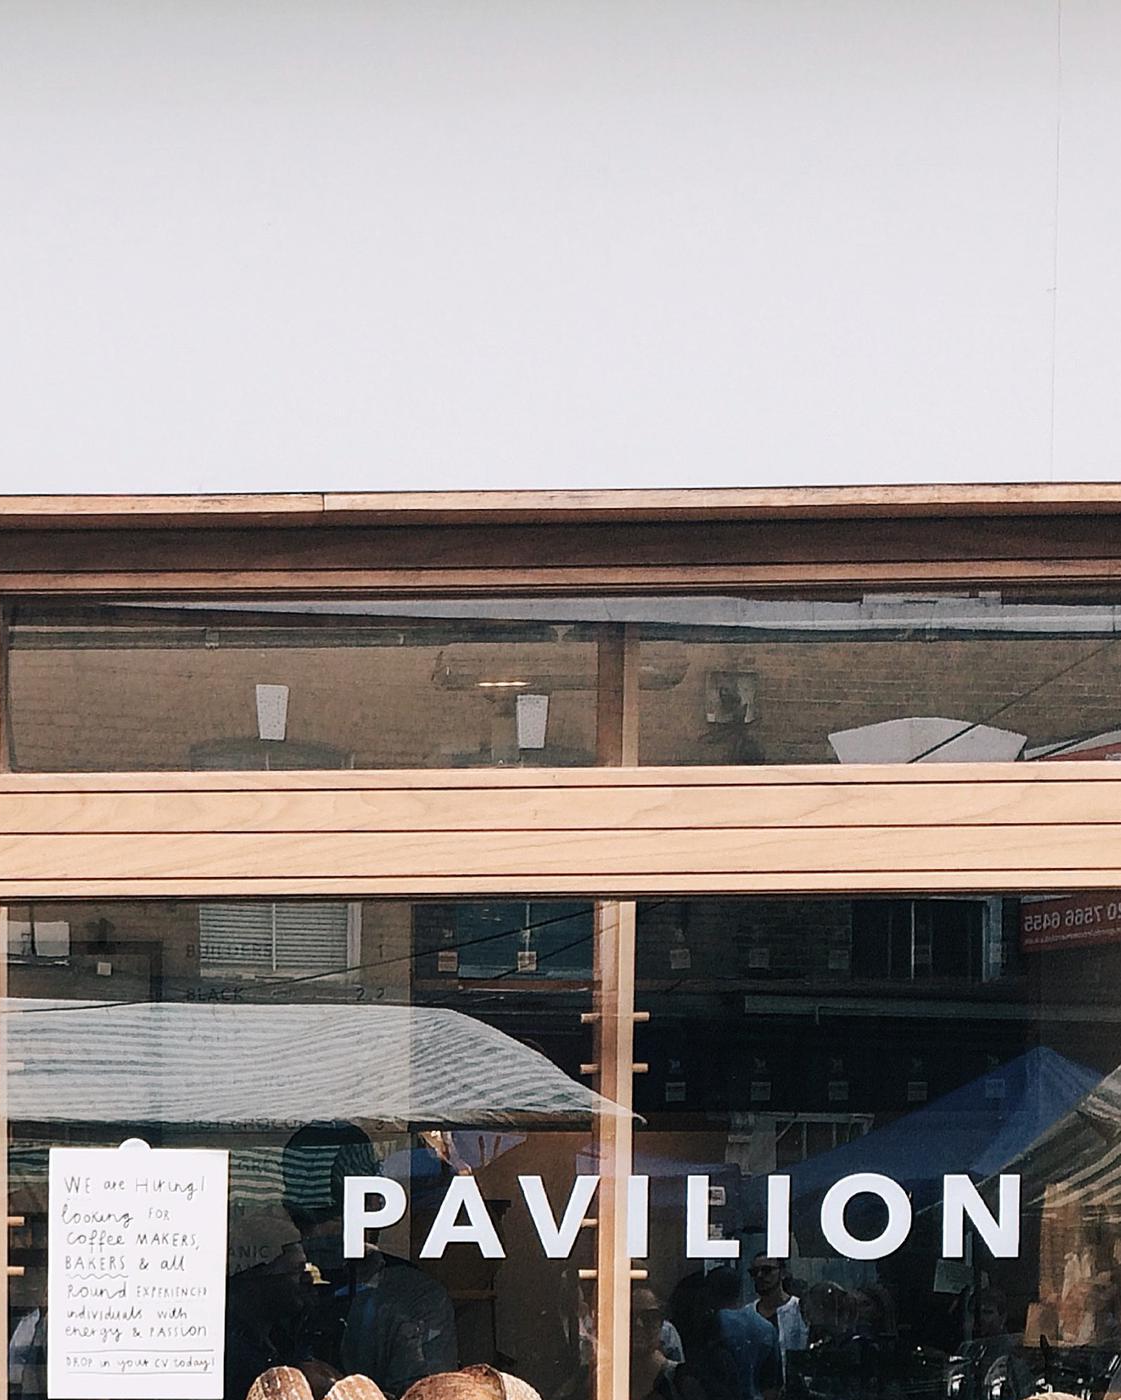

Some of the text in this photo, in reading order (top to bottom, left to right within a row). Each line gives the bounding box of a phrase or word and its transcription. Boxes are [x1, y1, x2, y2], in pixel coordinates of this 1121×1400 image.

[64, 1175, 92, 1194] WE
[103, 1180, 126, 1191] are
[148, 1207, 173, 1221] FOR
[342, 1172, 1020, 1261] PAVILION
[65, 1254, 186, 1271] BAKERS & all
[66, 1305, 188, 1321] individuals with
[65, 1325, 124, 1344] energy
[132, 1327, 143, 1338] &
[66, 1356, 94, 1367] DROP
[100, 1358, 111, 1367] in
[118, 1357, 149, 1373] your
[154, 1357, 169, 1367] CV
